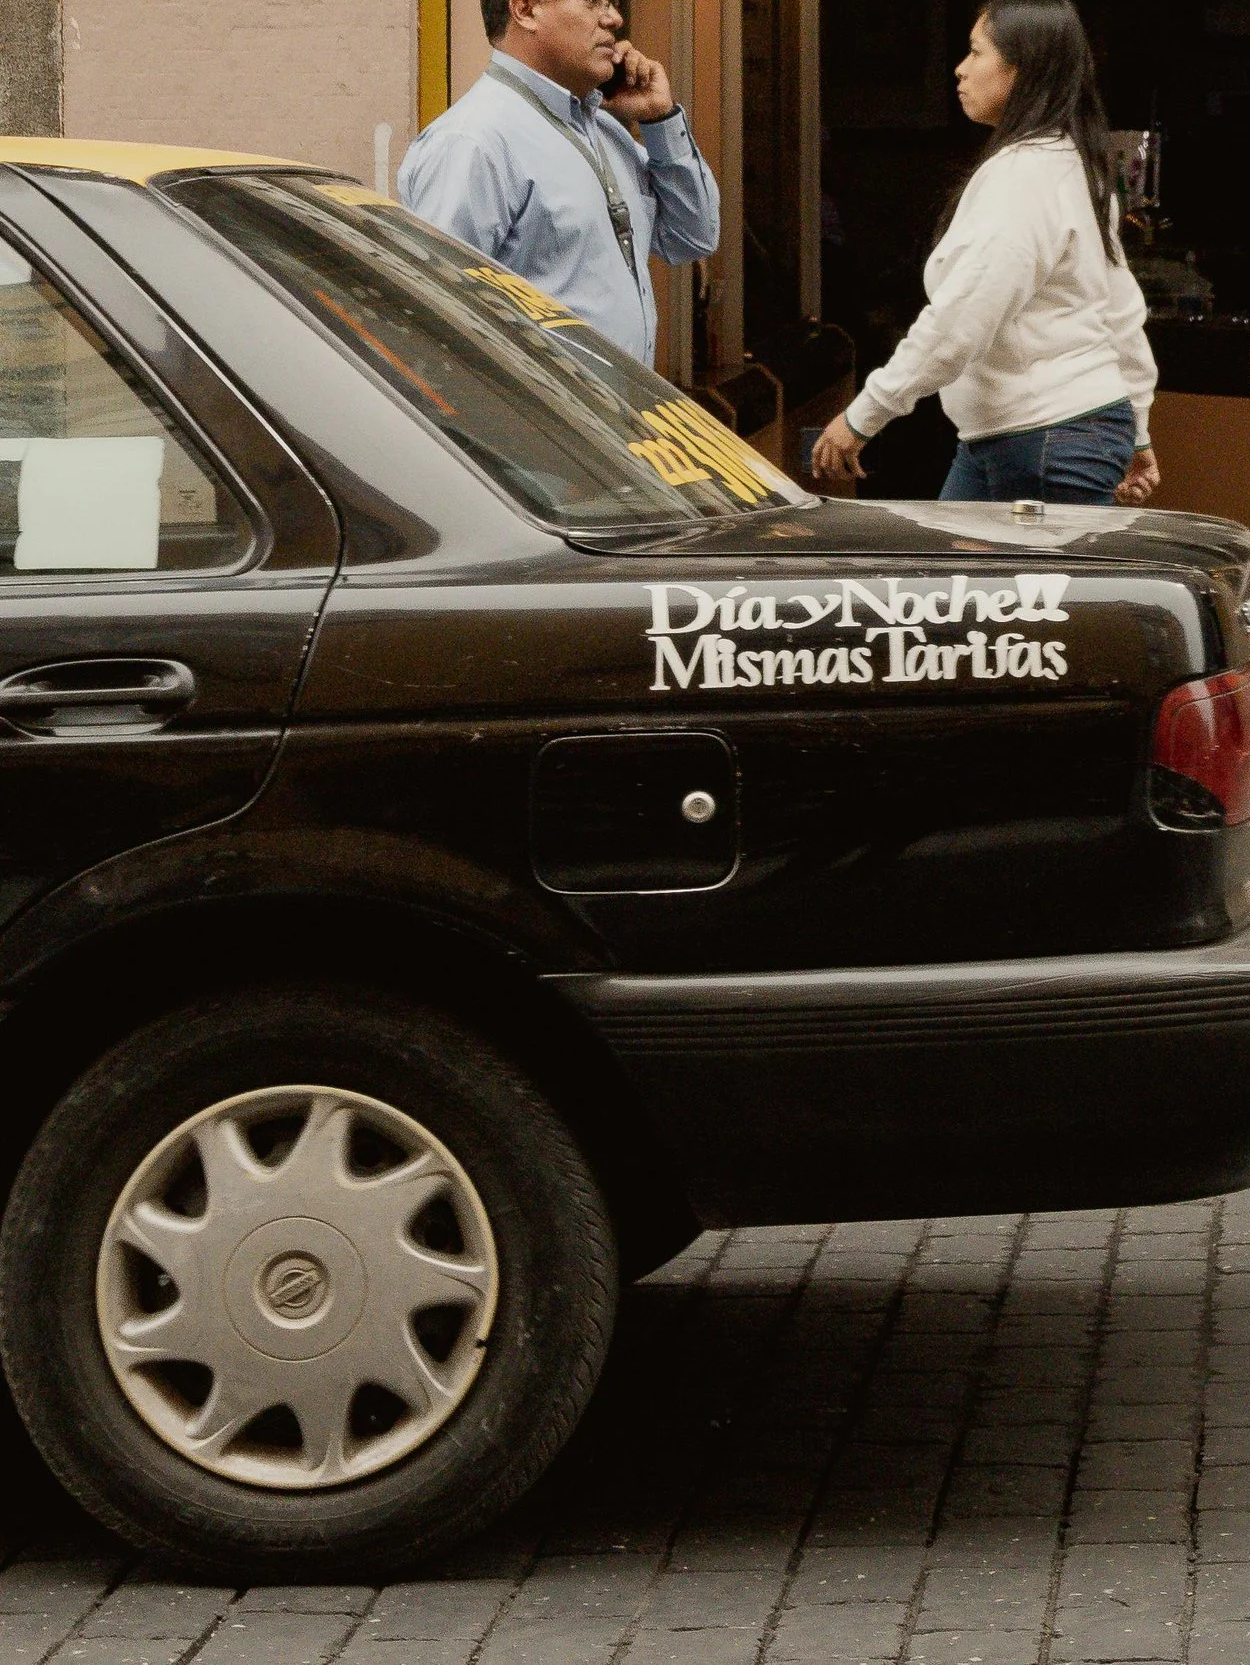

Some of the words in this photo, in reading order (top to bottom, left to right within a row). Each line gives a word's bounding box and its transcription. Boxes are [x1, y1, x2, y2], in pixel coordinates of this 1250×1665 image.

[642, 584, 784, 635] Día
[647, 634, 873, 692] Mismas
[865, 625, 1069, 682] Tarifas
